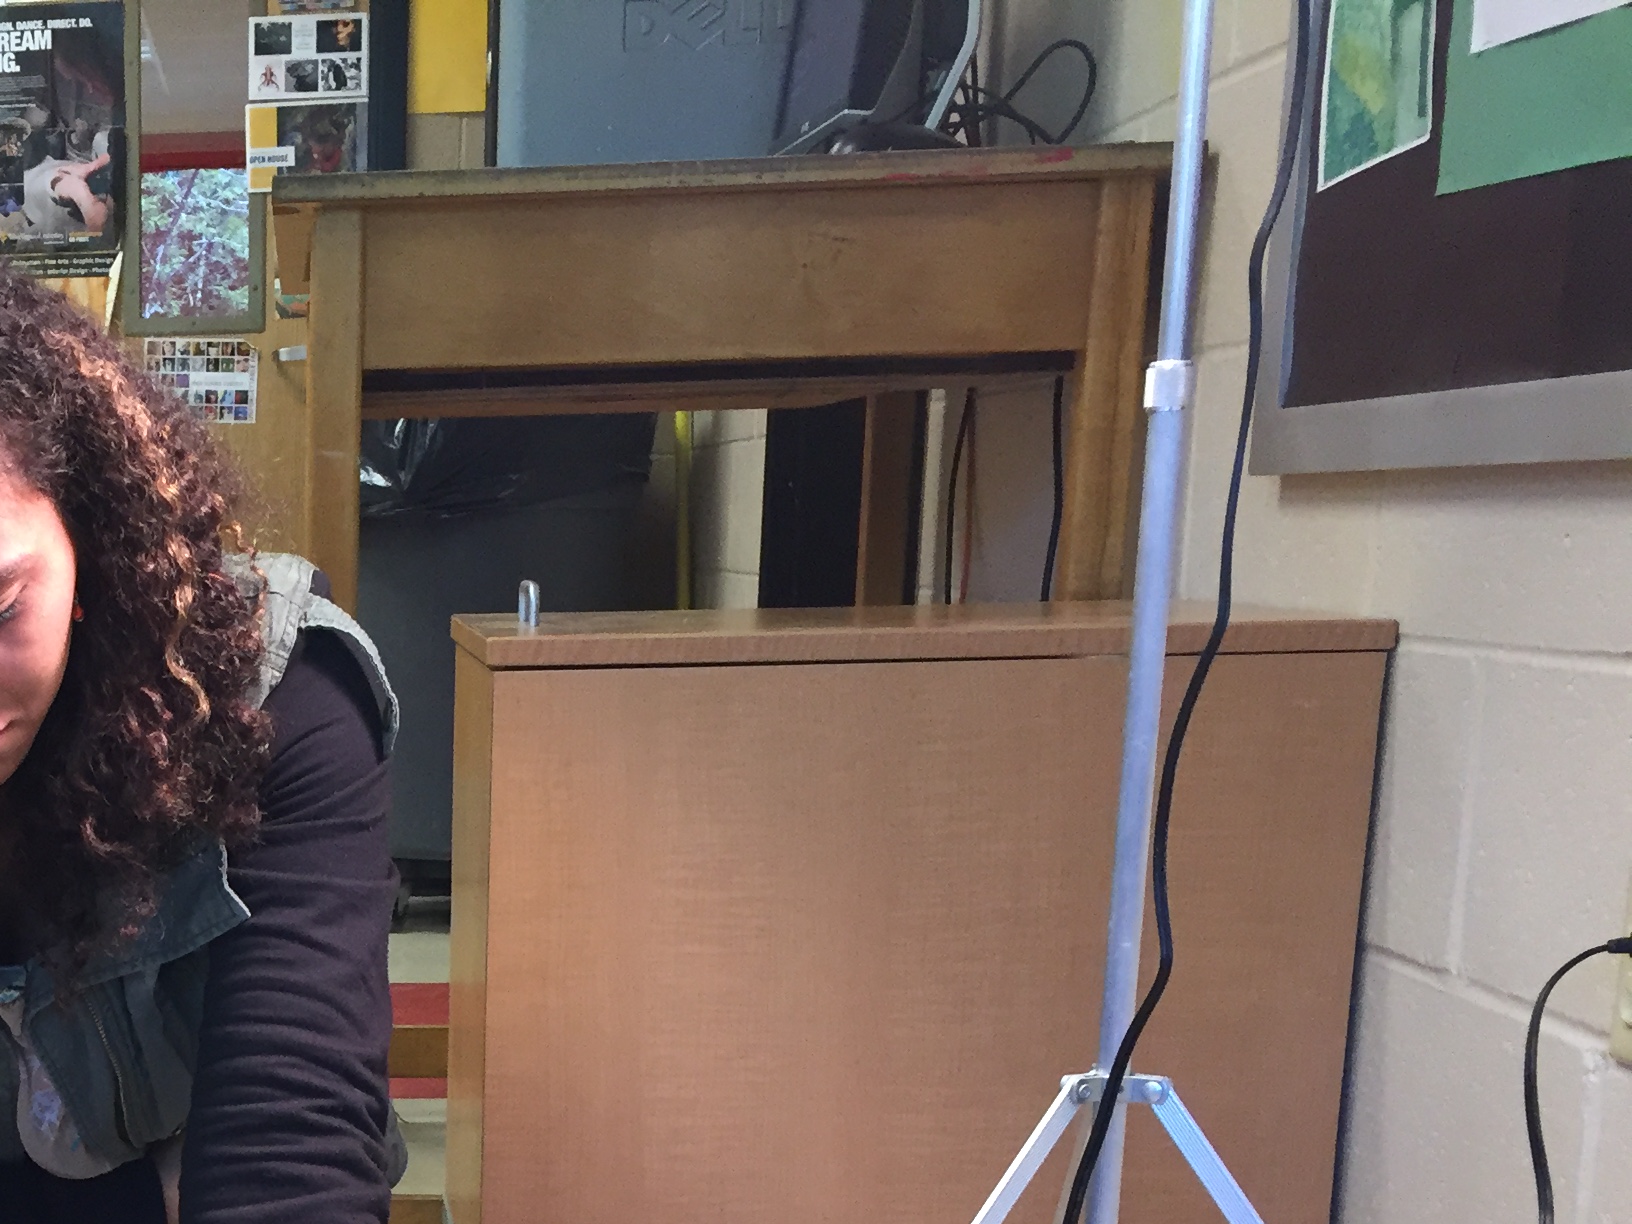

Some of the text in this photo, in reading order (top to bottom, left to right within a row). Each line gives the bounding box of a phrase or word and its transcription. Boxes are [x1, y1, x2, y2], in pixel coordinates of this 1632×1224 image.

[16, 20, 45, 30] DANCE.
[47, 18, 77, 29] DIRECT.
[79, 17, 93, 28] DO.
